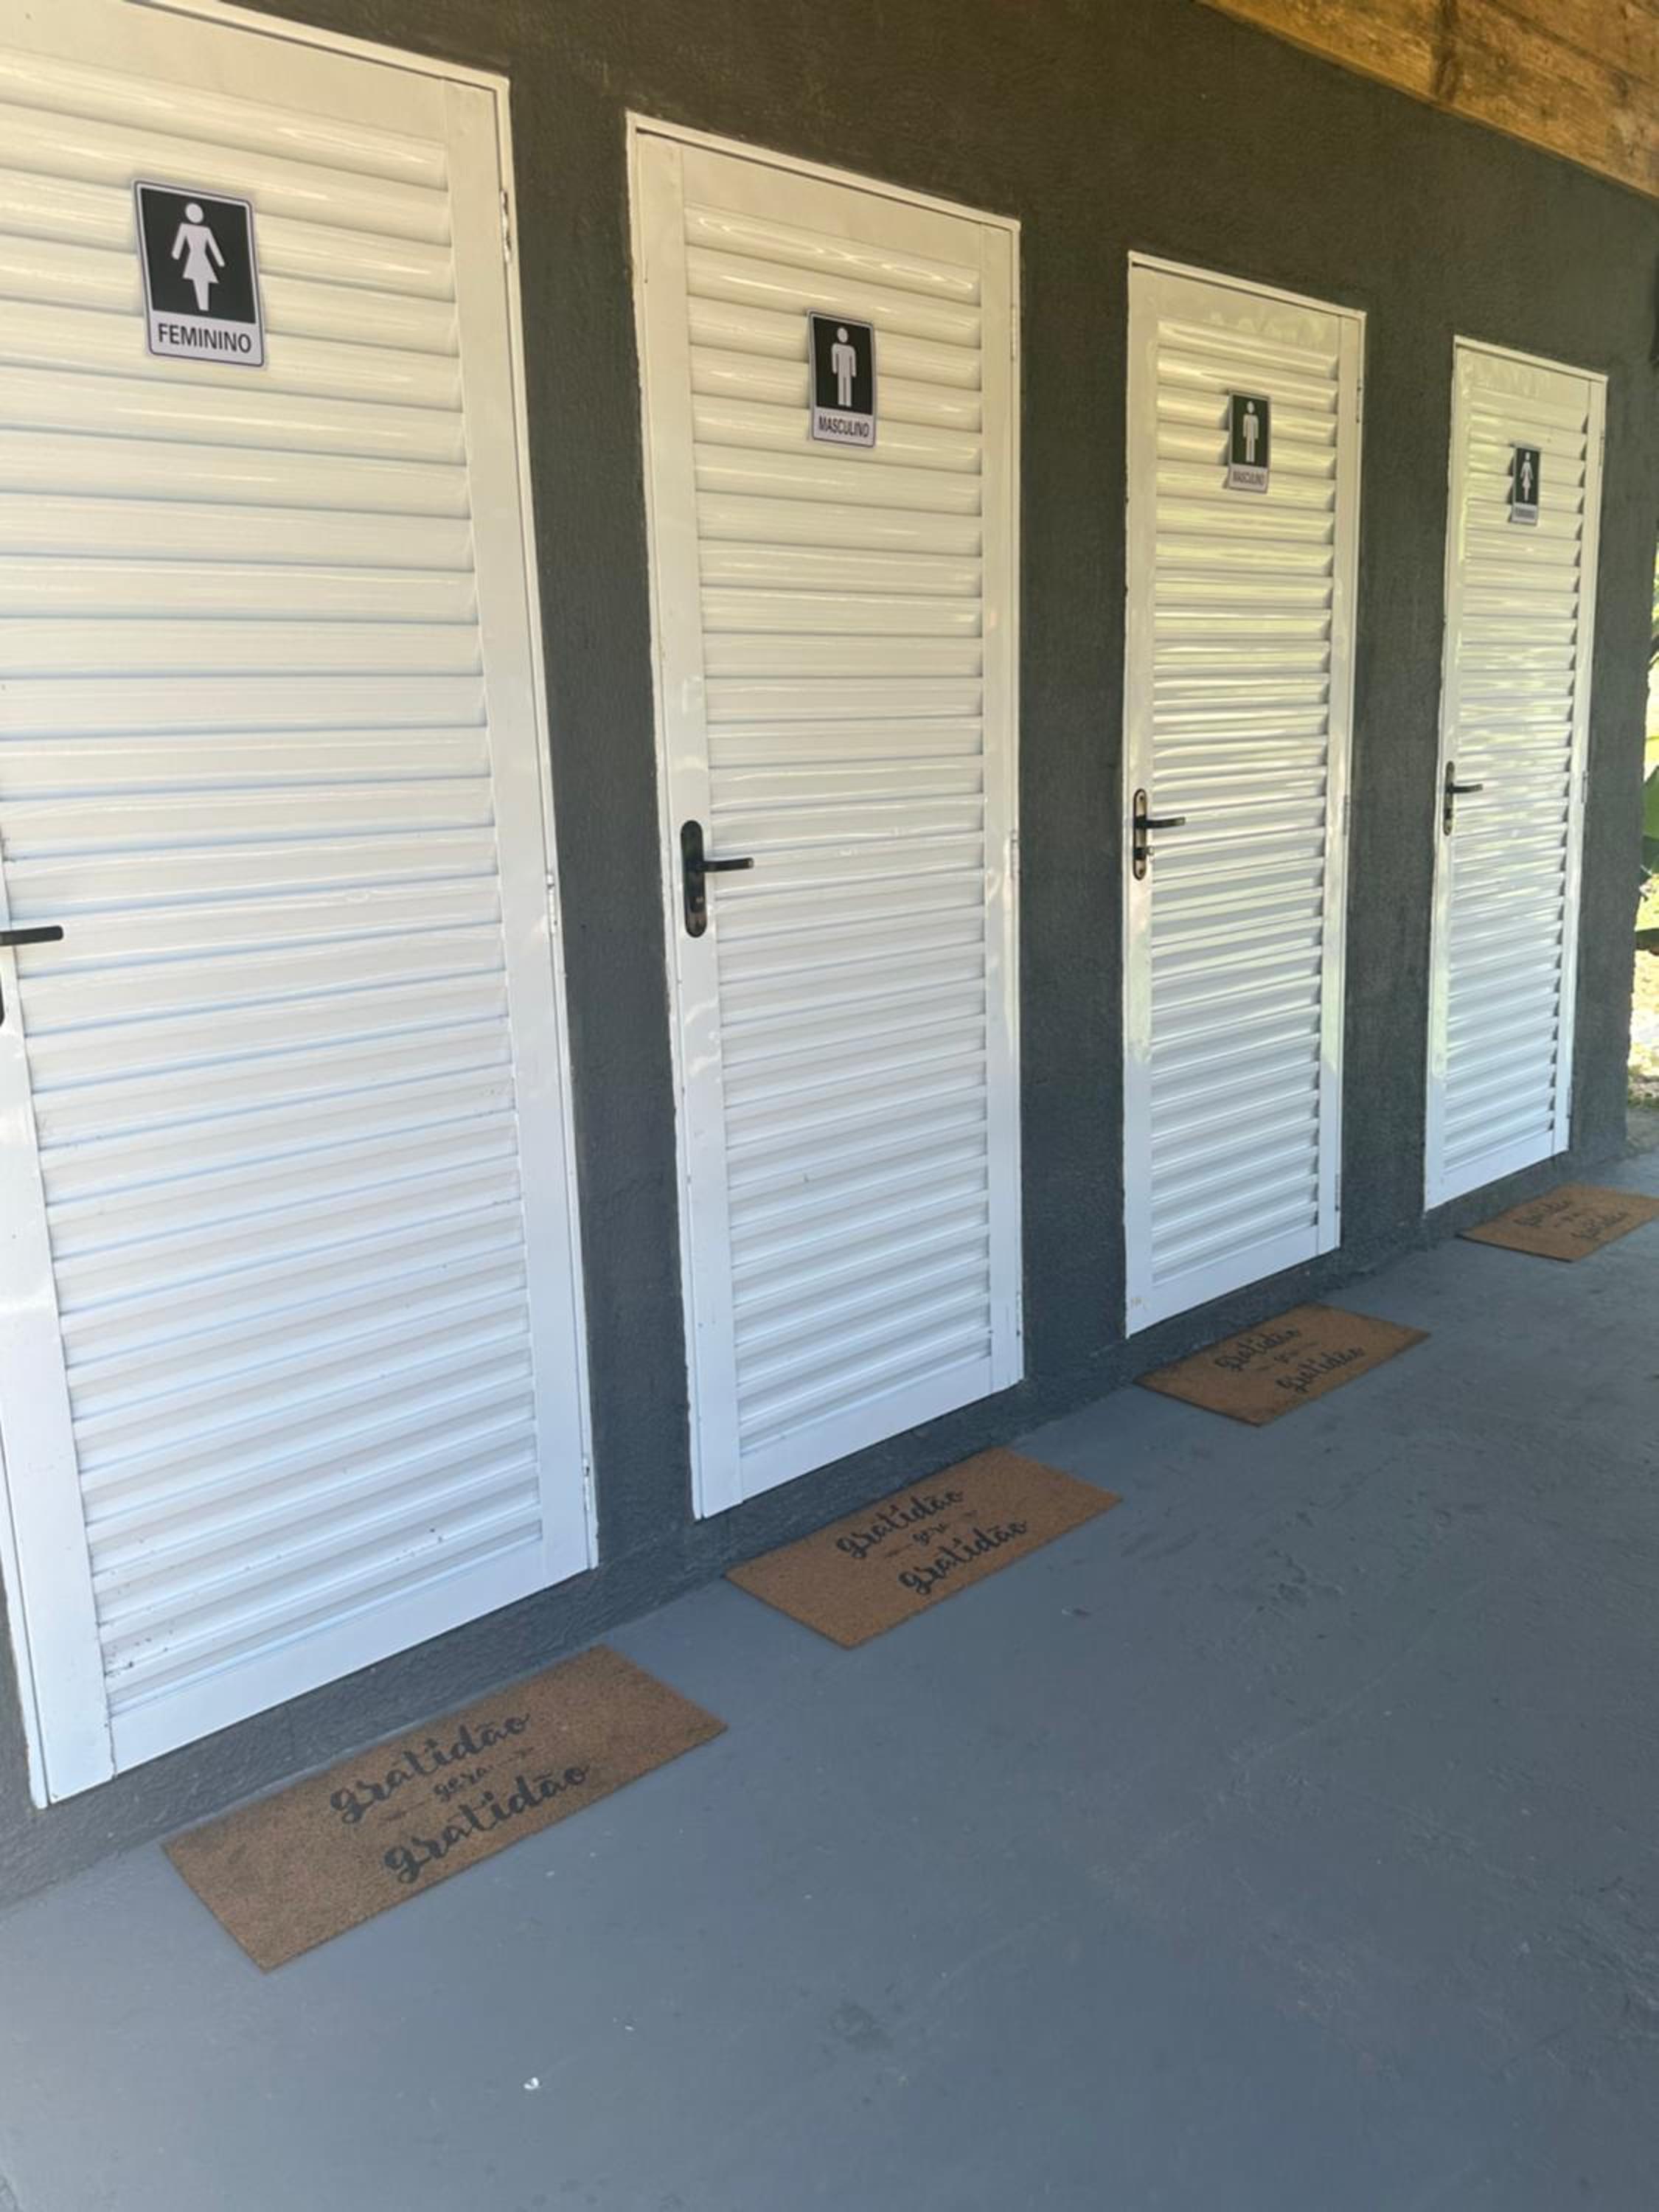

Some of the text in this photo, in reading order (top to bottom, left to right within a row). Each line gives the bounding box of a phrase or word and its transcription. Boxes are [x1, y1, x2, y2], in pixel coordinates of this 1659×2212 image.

[158, 322, 252, 354] FEMININO
[818, 414, 870, 438] MASCULINO
[897, 1520, 1027, 1596] gratidão
[330, 1713, 530, 1824] gratidão
[383, 1765, 590, 1884] gratidão
